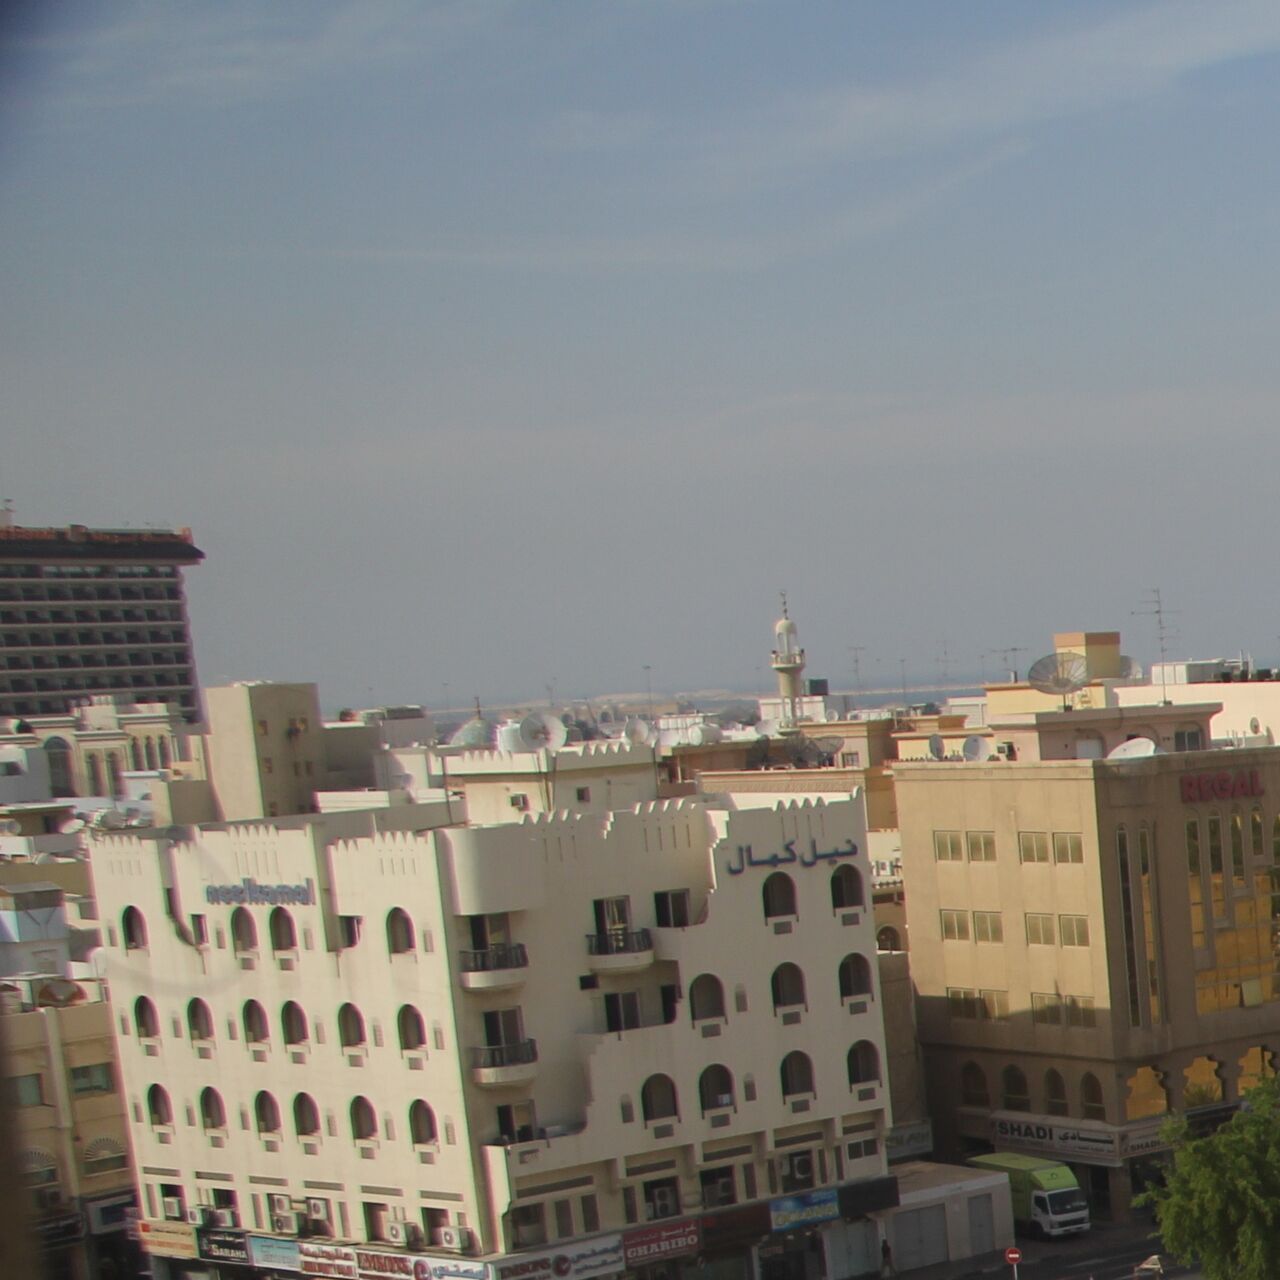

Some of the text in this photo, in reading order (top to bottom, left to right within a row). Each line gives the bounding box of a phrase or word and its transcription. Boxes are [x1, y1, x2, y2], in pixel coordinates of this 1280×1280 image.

[1180, 769, 1265, 804] REGAL
[727, 838, 858, 875] نيل كمال
[997, 1121, 1054, 1141] SHADI
[627, 1234, 698, 1259] GHARIBO
